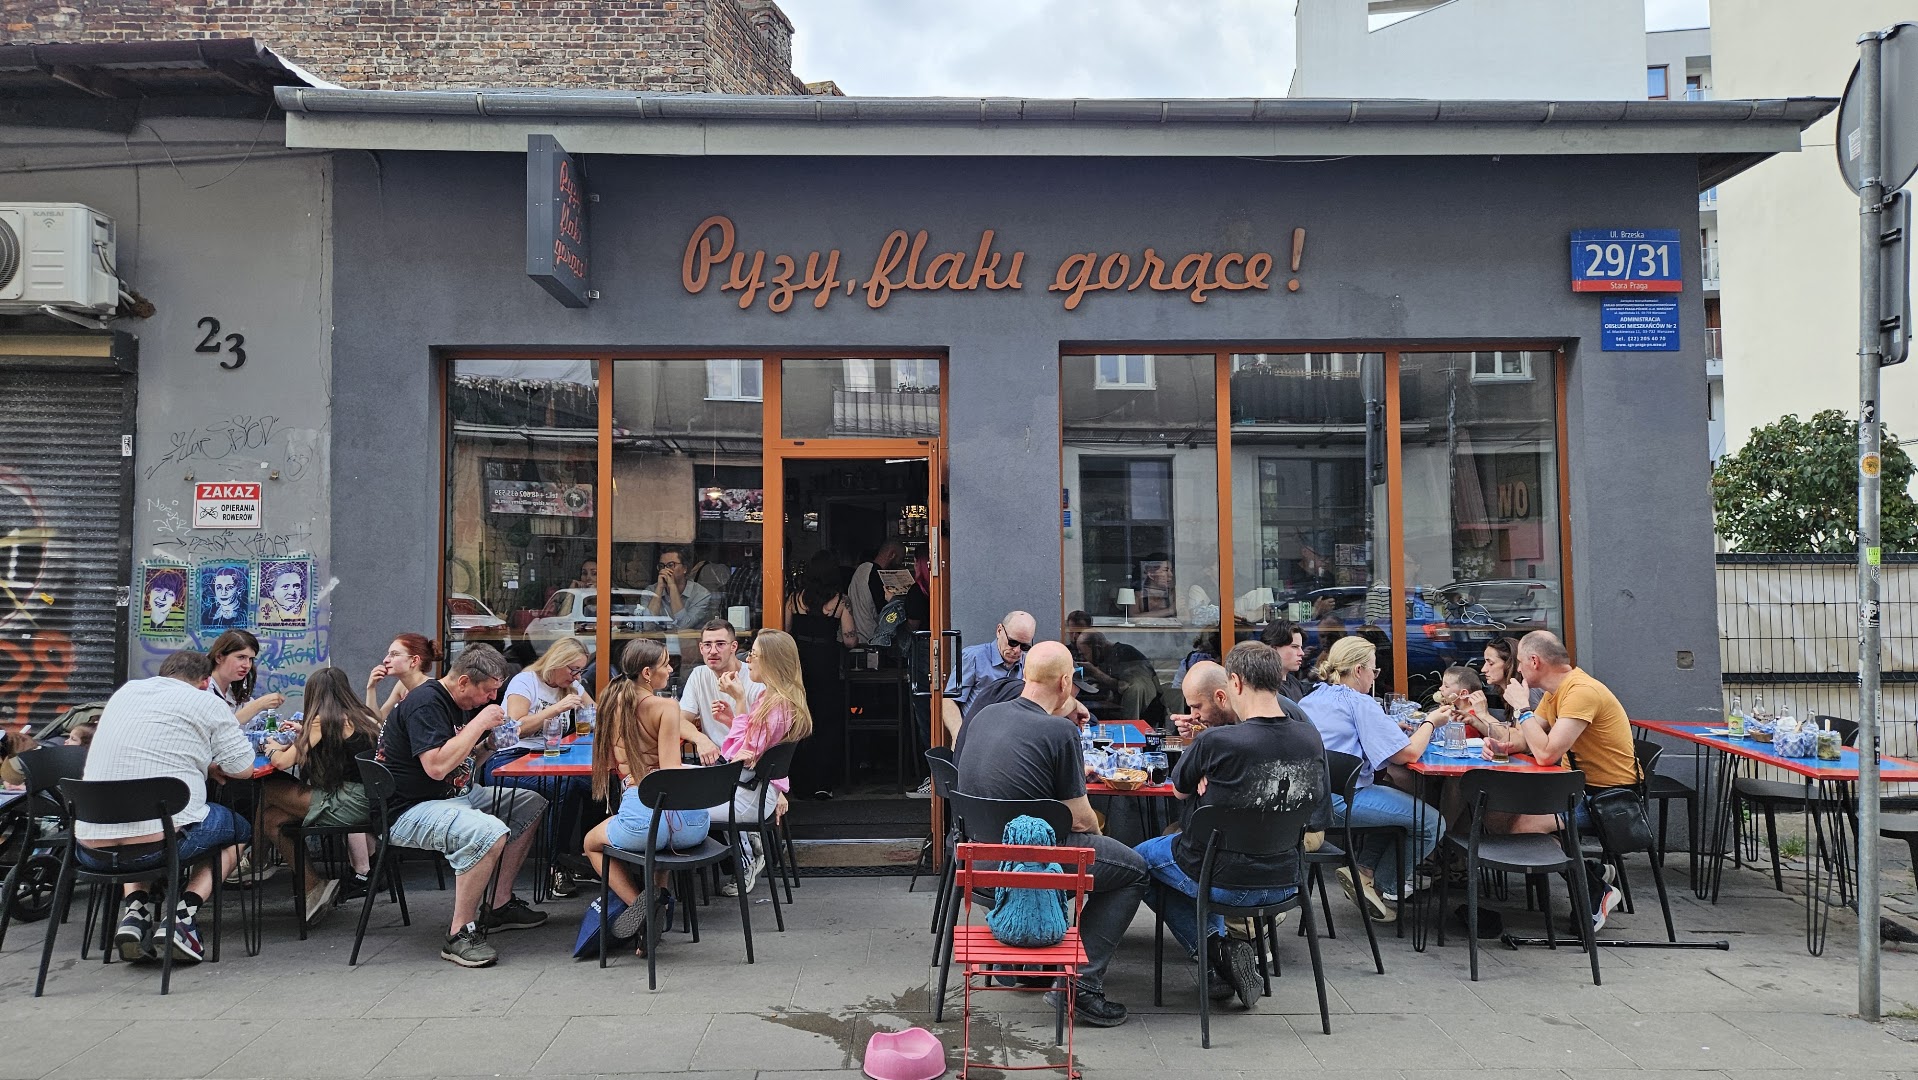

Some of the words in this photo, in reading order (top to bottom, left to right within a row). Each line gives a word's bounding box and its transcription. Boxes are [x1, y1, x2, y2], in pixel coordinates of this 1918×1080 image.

[1621, 231, 1645, 239] Brzeska
[1585, 244, 1669, 280] 29/31
[1630, 282, 1648, 291] Praga
[195, 316, 246, 369] 23
[202, 486, 255, 498] ZAKAZ
[220, 504, 255, 512] OPIERANIA
[222, 512, 253, 521] ROWERÓW
